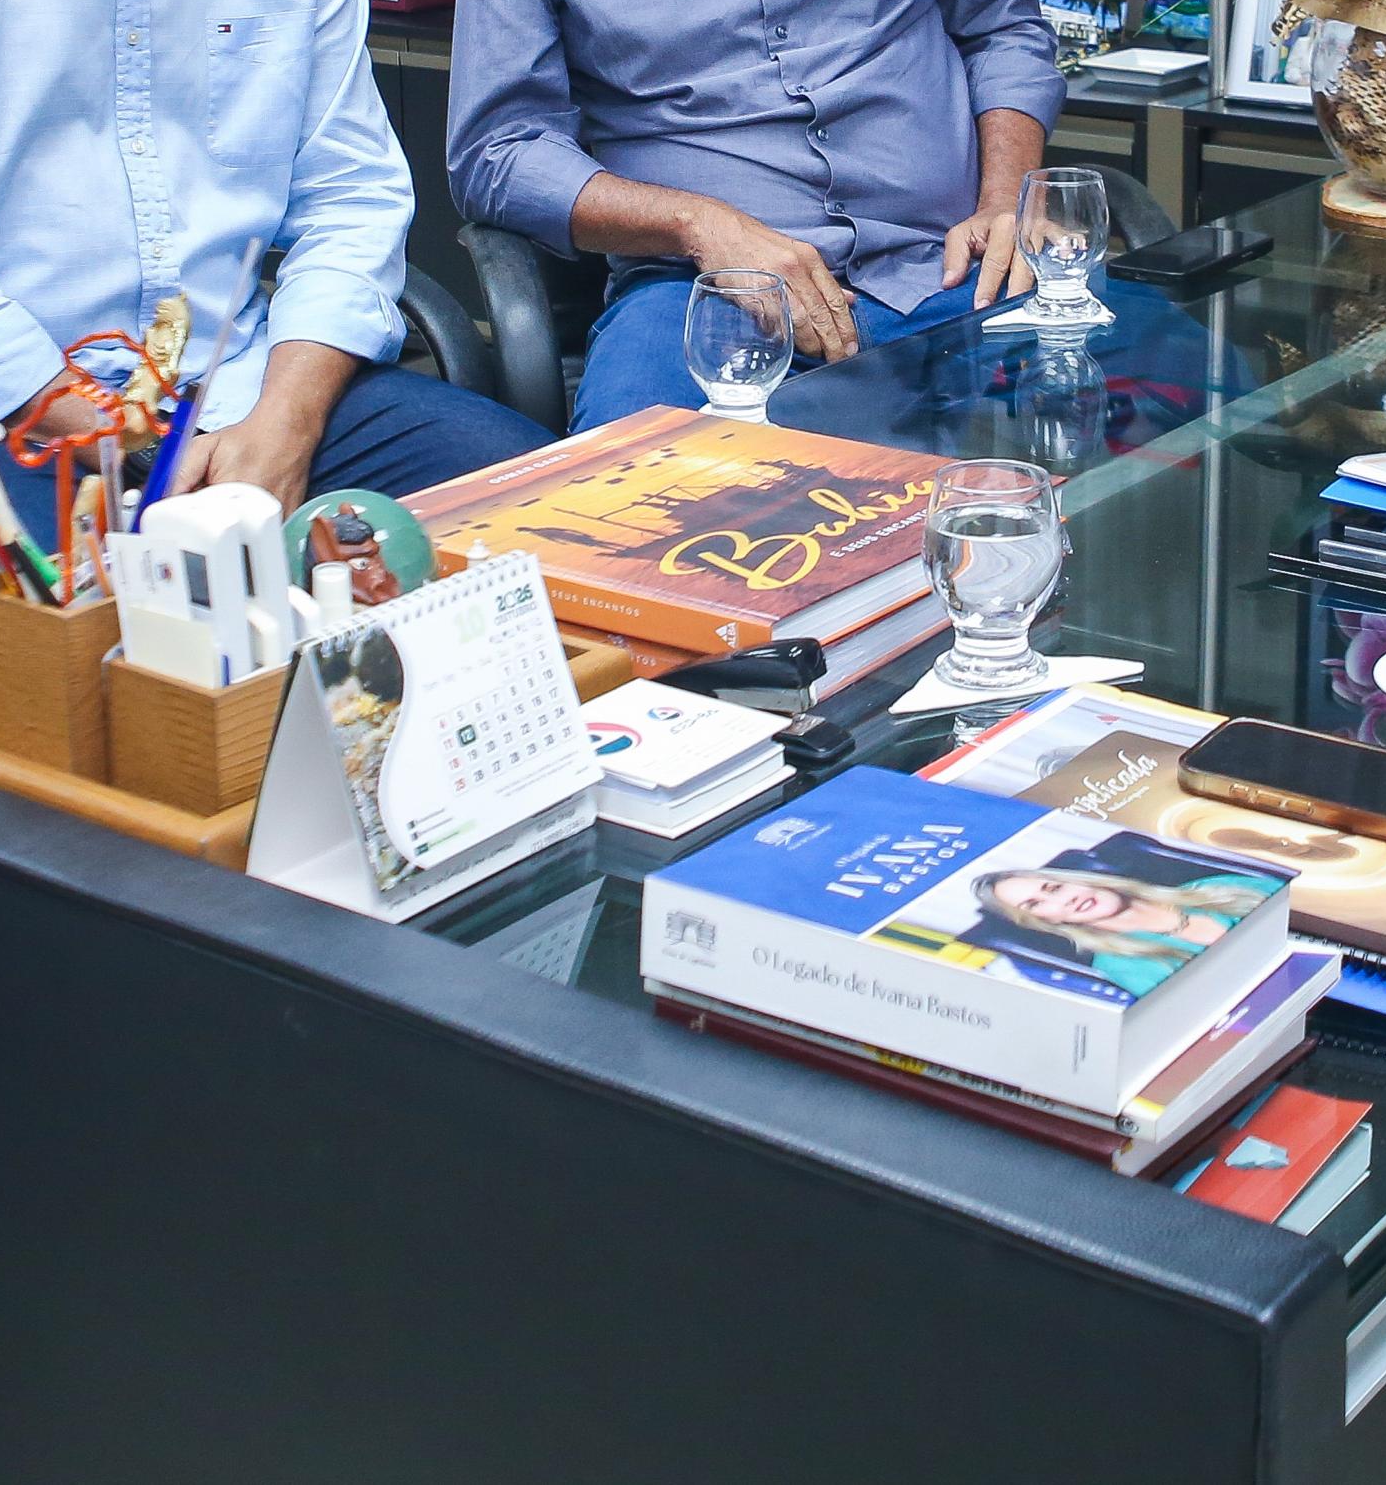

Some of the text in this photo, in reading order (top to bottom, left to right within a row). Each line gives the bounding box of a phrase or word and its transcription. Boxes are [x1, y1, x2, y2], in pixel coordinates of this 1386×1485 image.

[532, 452, 572, 469] GAMA
[659, 478, 939, 591] Bahia
[829, 547, 845, 559] E
[843, 533, 879, 555] SEUS
[550, 590, 640, 619] SEUS ENCANTOS
[825, 823, 966, 899] IVANA
[882, 838, 970, 895] BASTOS
[751, 946, 771, 966] O
[771, 948, 840, 989] Legado
[843, 973, 866, 996] de
[871, 978, 923, 1011] Ivana
[925, 994, 993, 1031] Bastos
